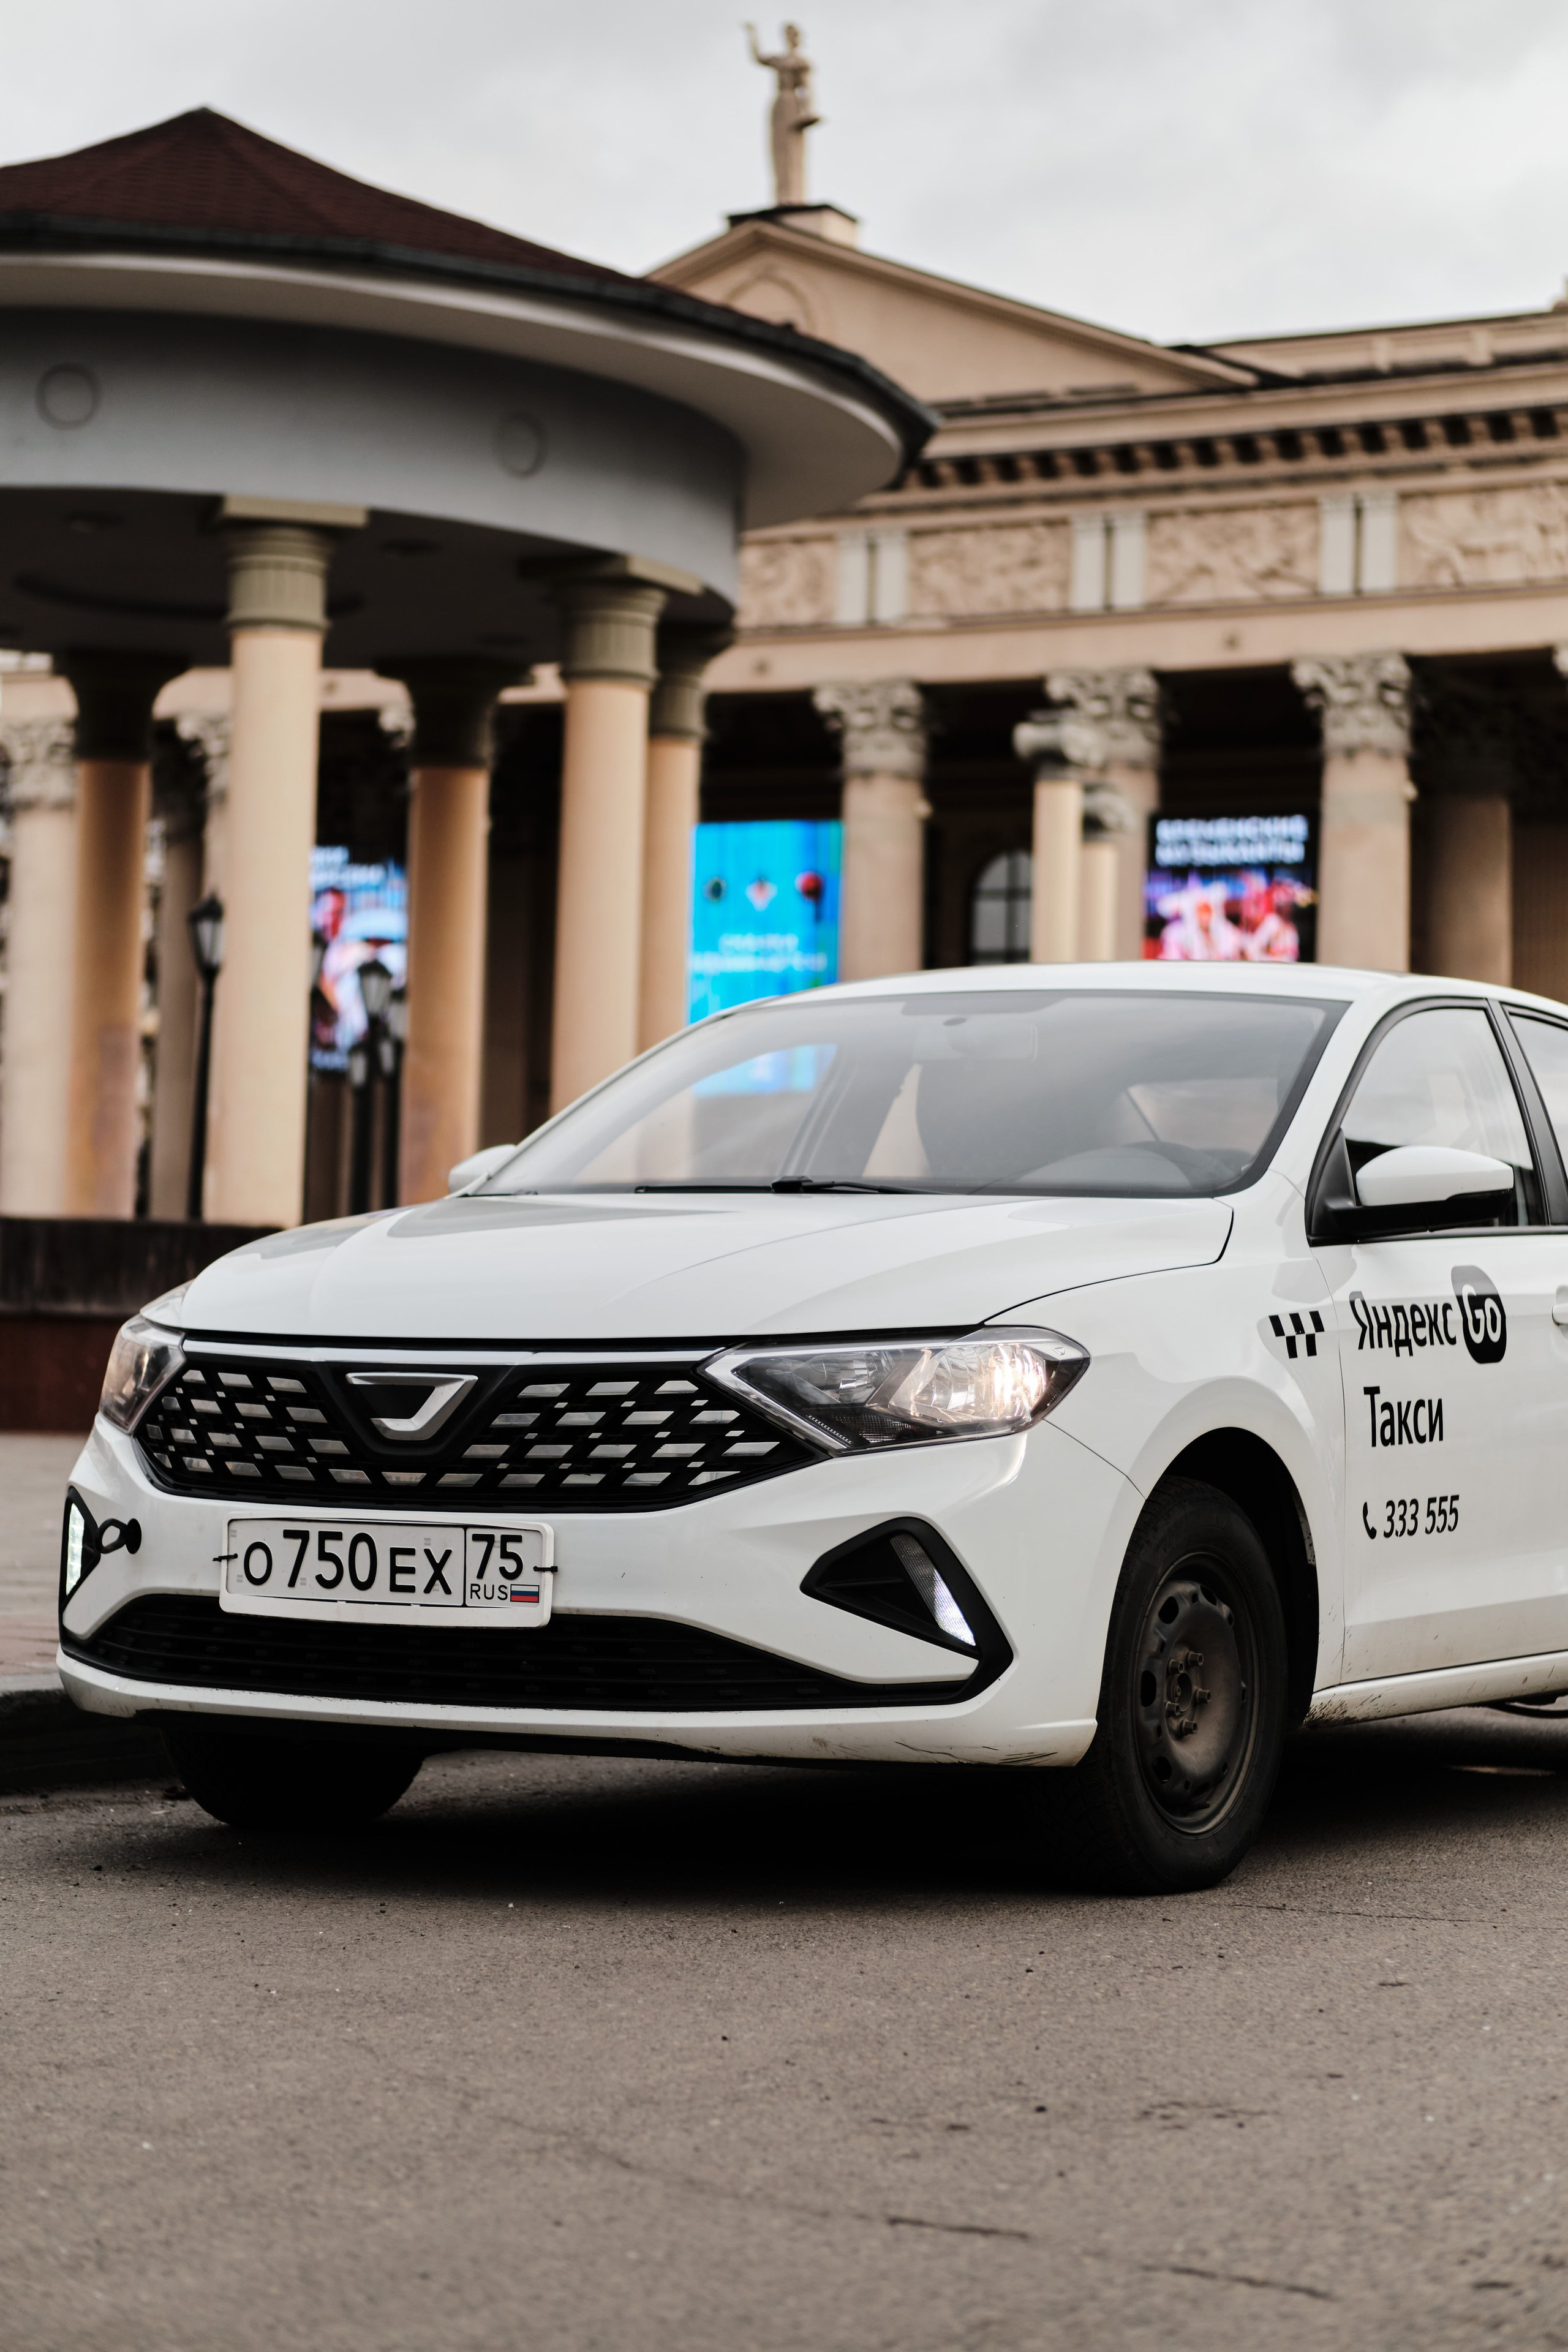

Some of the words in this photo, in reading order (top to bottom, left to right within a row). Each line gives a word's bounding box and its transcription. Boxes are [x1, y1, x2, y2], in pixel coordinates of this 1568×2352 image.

[1349, 1291, 1457, 1357] Яндекс
[1461, 1284, 1502, 1344] Go
[1363, 1385, 1444, 1447] Такси
[1383, 1498, 1419, 1539] 333
[1425, 1494, 1460, 1535] 555
[472, 1533, 524, 1581] 75
[470, 1583, 508, 1601] RUS
